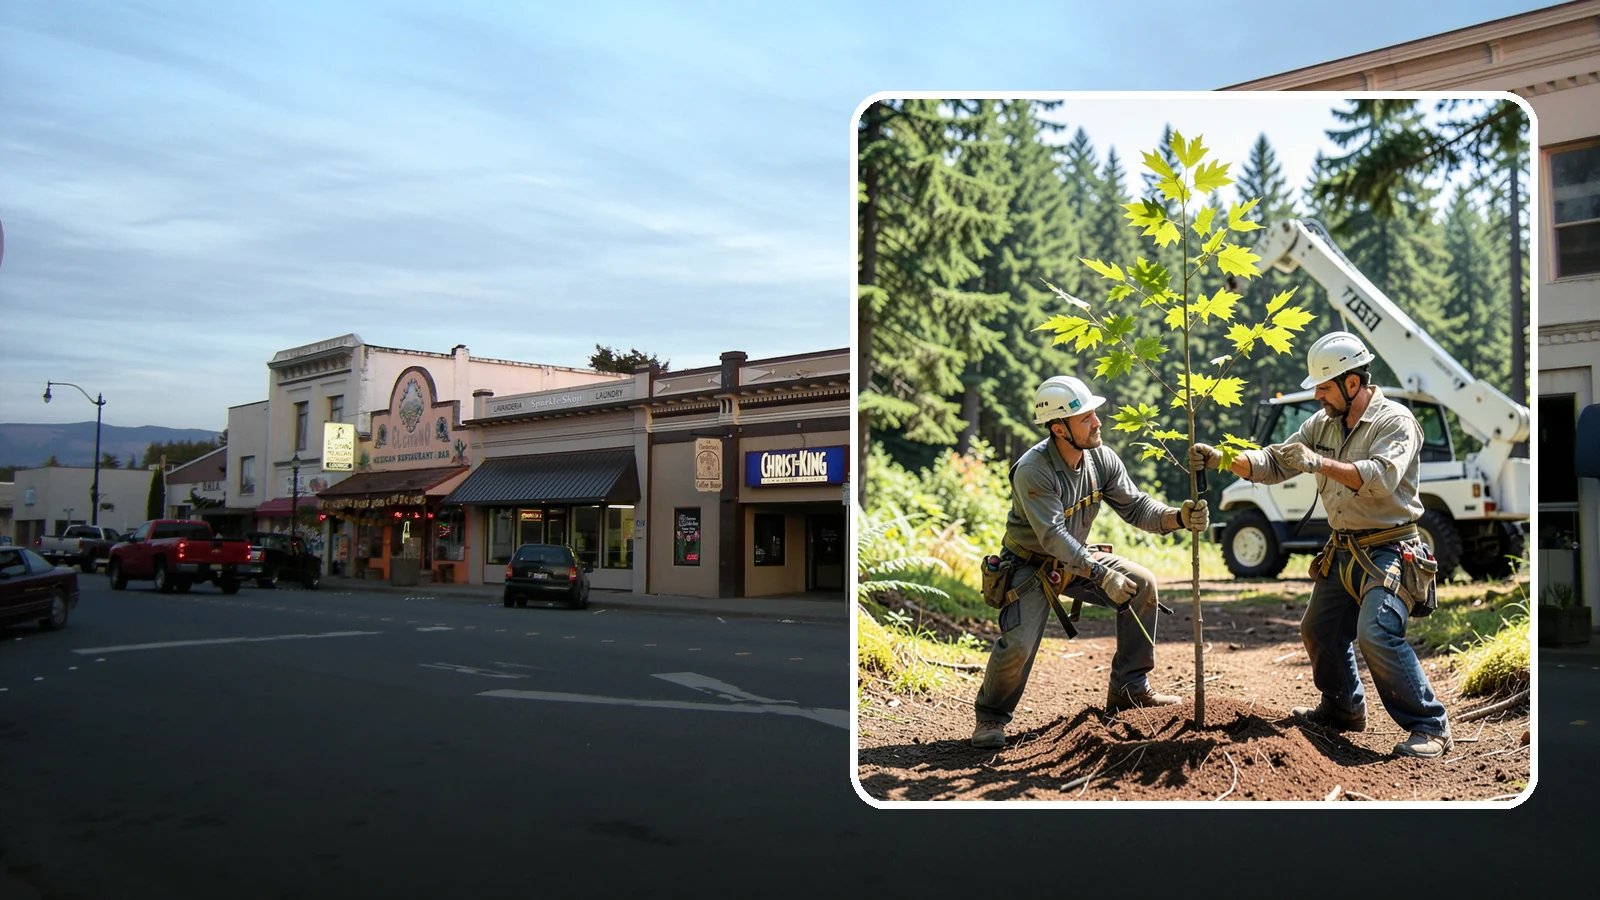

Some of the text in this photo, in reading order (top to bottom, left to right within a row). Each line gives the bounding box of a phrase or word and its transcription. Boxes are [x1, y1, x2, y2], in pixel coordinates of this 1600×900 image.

[562, 394, 582, 405] Shop
[595, 389, 624, 399] LAUNDRY
[493, 402, 522, 412] LAVANDERIA
[373, 450, 450, 464] MEXICAN RESTAURANT BAR
[761, 450, 827, 478] CHRIST KING
